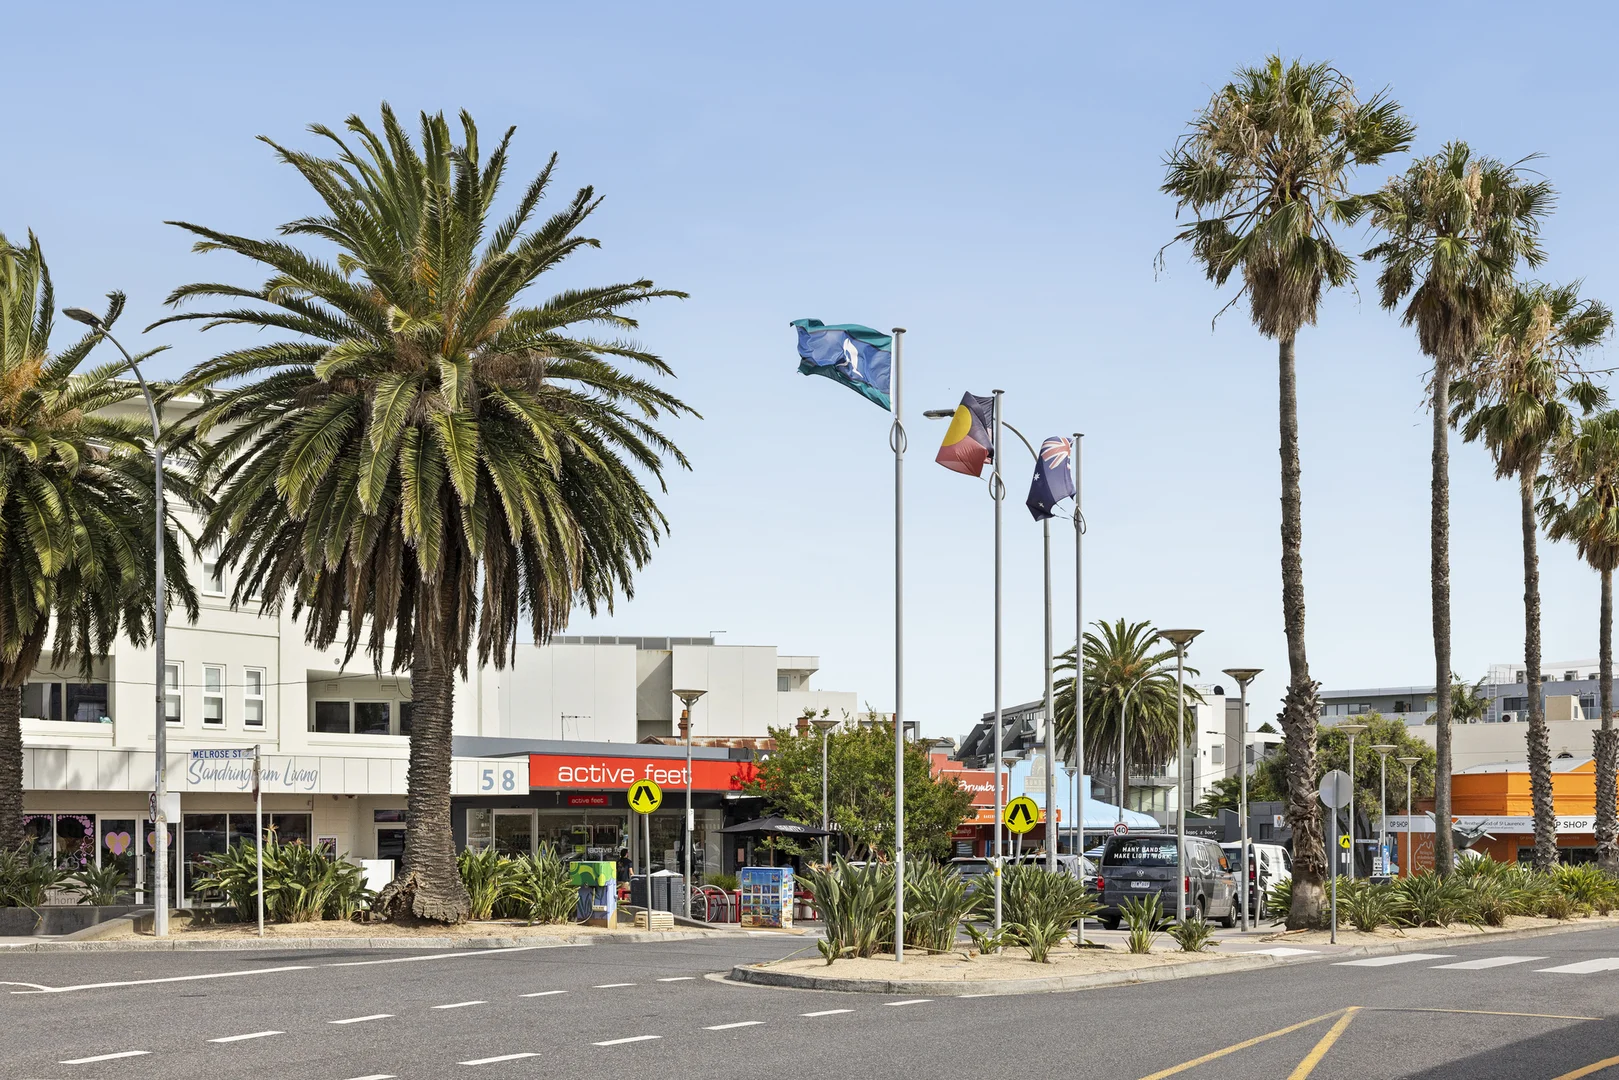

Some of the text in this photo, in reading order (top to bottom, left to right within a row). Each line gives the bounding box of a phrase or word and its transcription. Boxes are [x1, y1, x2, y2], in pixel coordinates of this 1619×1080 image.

[192, 748, 242, 759] MELROSE ST
[186, 758, 319, 790] Sandringam Living
[481, 769, 515, 791] 58
[557, 762, 693, 785] active feet
[1563, 821, 1588, 829] SHOP
